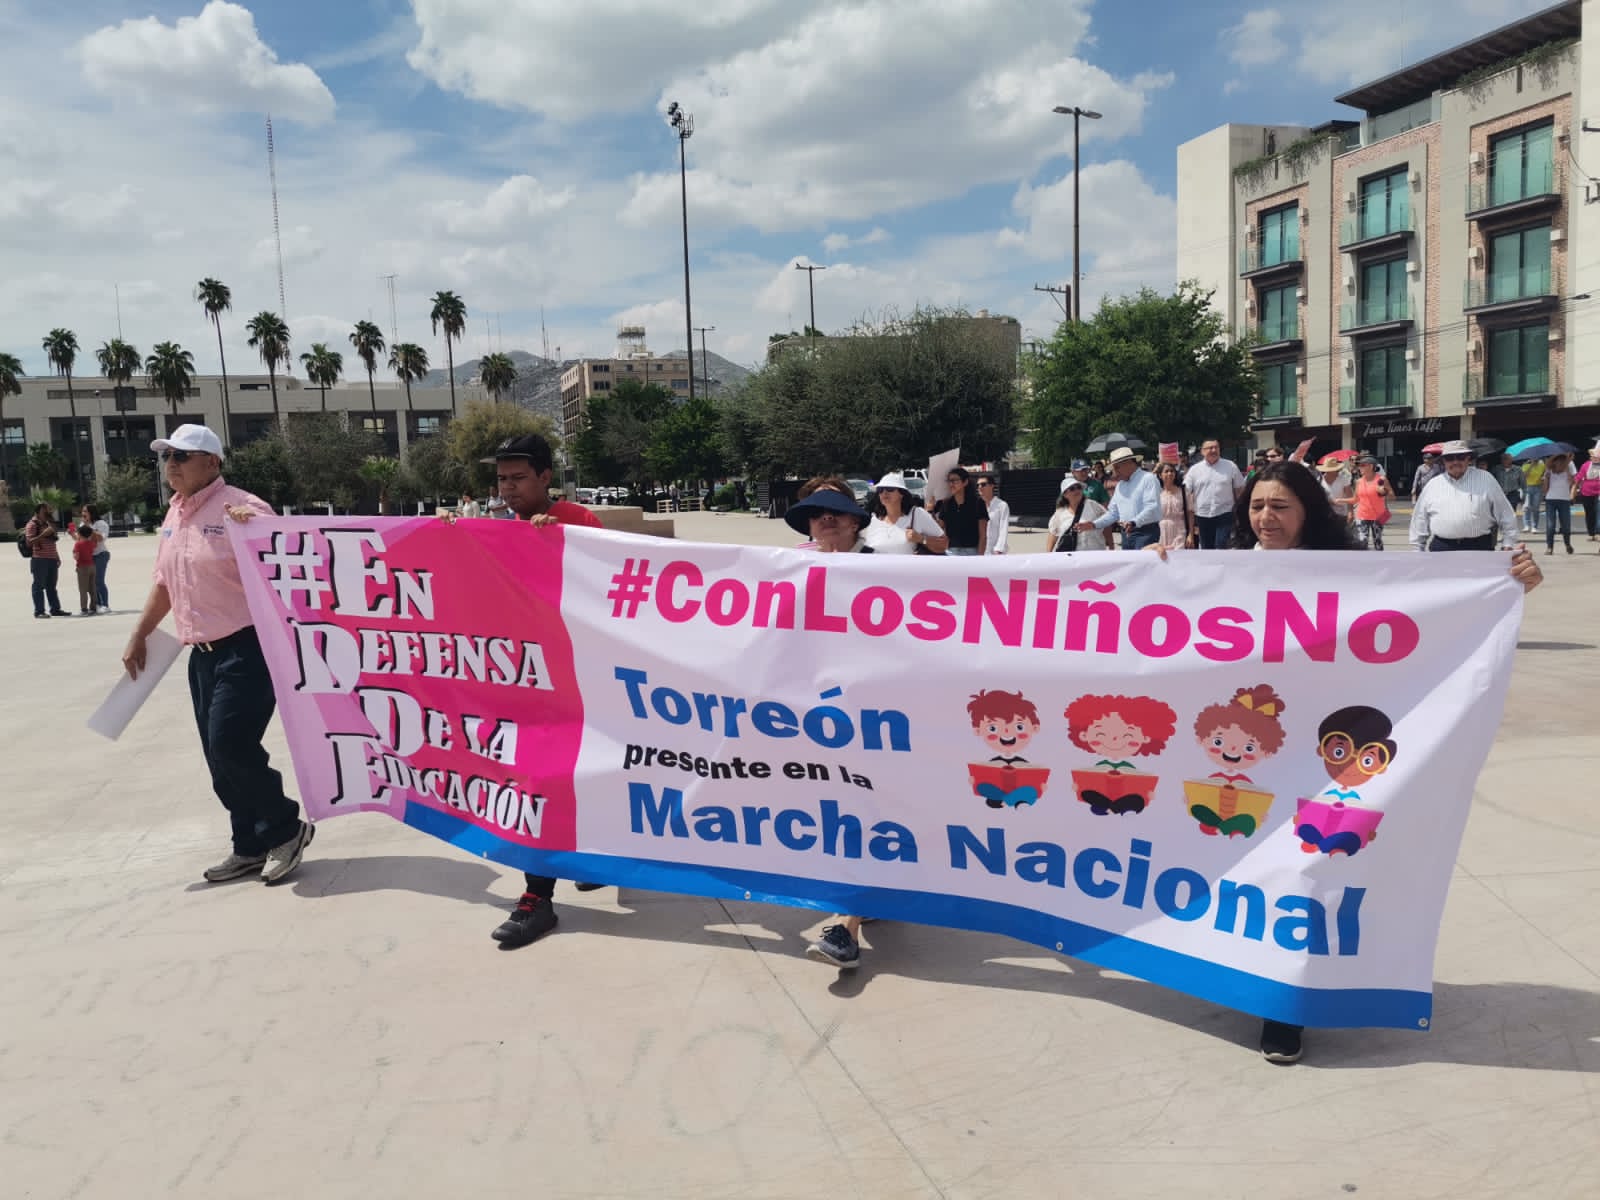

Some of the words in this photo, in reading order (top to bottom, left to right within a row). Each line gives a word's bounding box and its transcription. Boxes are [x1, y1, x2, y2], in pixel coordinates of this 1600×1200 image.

[1387, 420, 1412, 433] Times
[607, 558, 1420, 664] #ConLosNiñosNo
[287, 617, 554, 694] DEFENSA
[614, 666, 911, 752] Torreón
[623, 743, 772, 779] presente
[782, 759, 830, 781] en
[838, 765, 874, 791] la
[628, 782, 918, 863] Marcha
[946, 824, 1367, 956] Nacional
